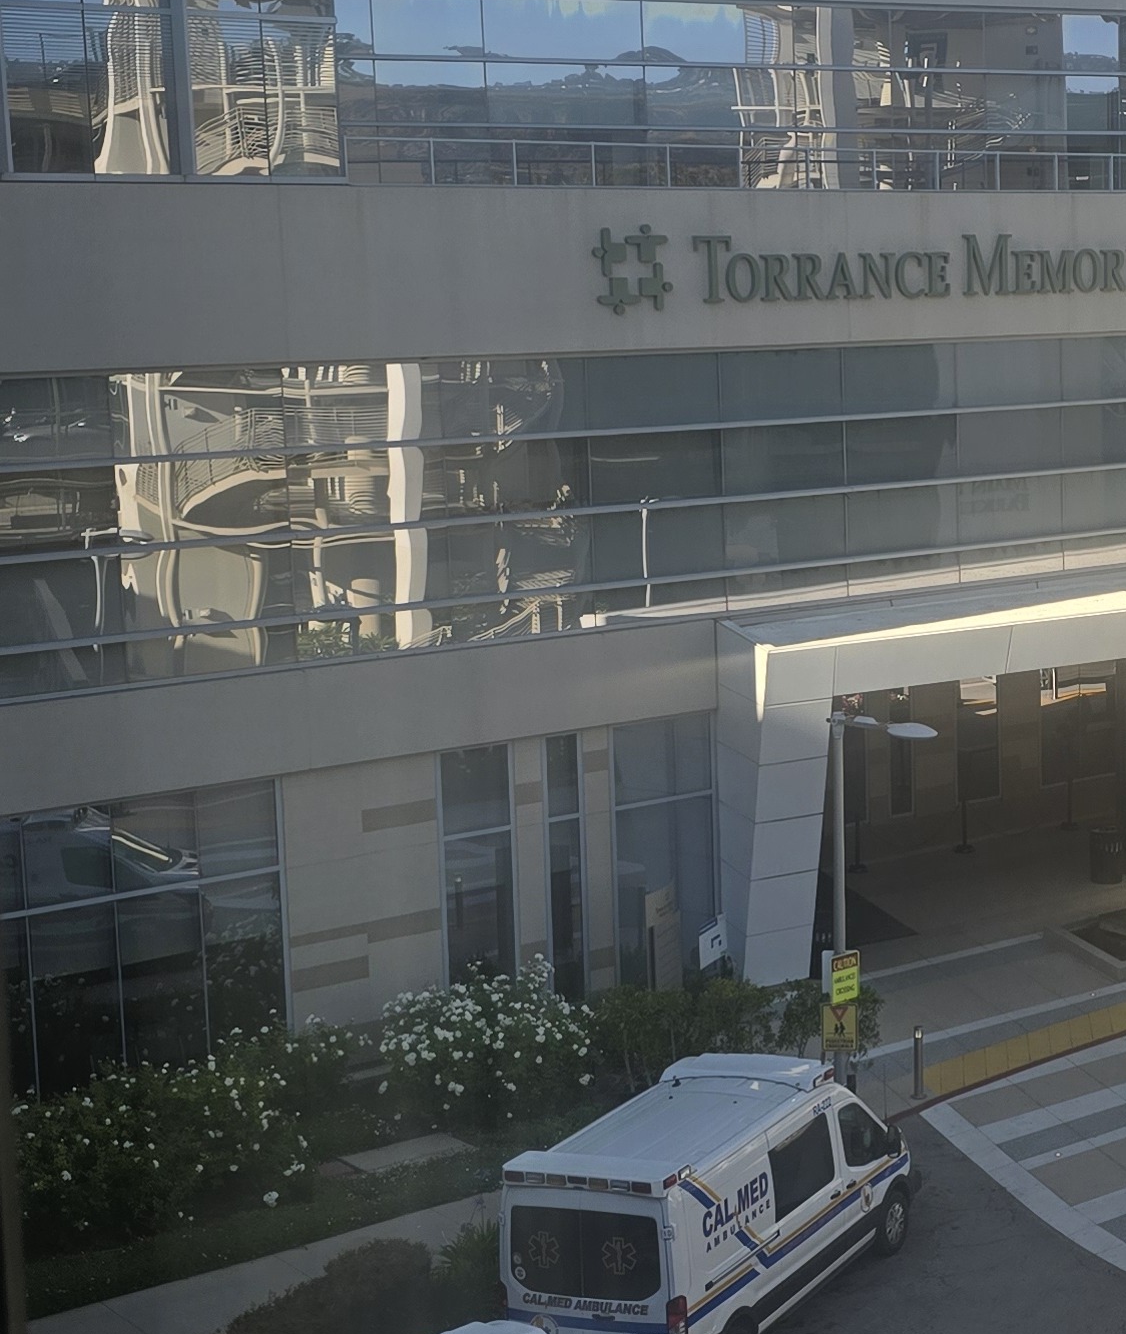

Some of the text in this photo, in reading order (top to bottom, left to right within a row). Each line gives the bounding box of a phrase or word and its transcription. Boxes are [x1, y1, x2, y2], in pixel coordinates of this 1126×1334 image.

[692, 235, 950, 304] TORRANCE
[706, 1198, 770, 1253] AMBULANCE
[574, 1299, 649, 1315] AMBULANCE
